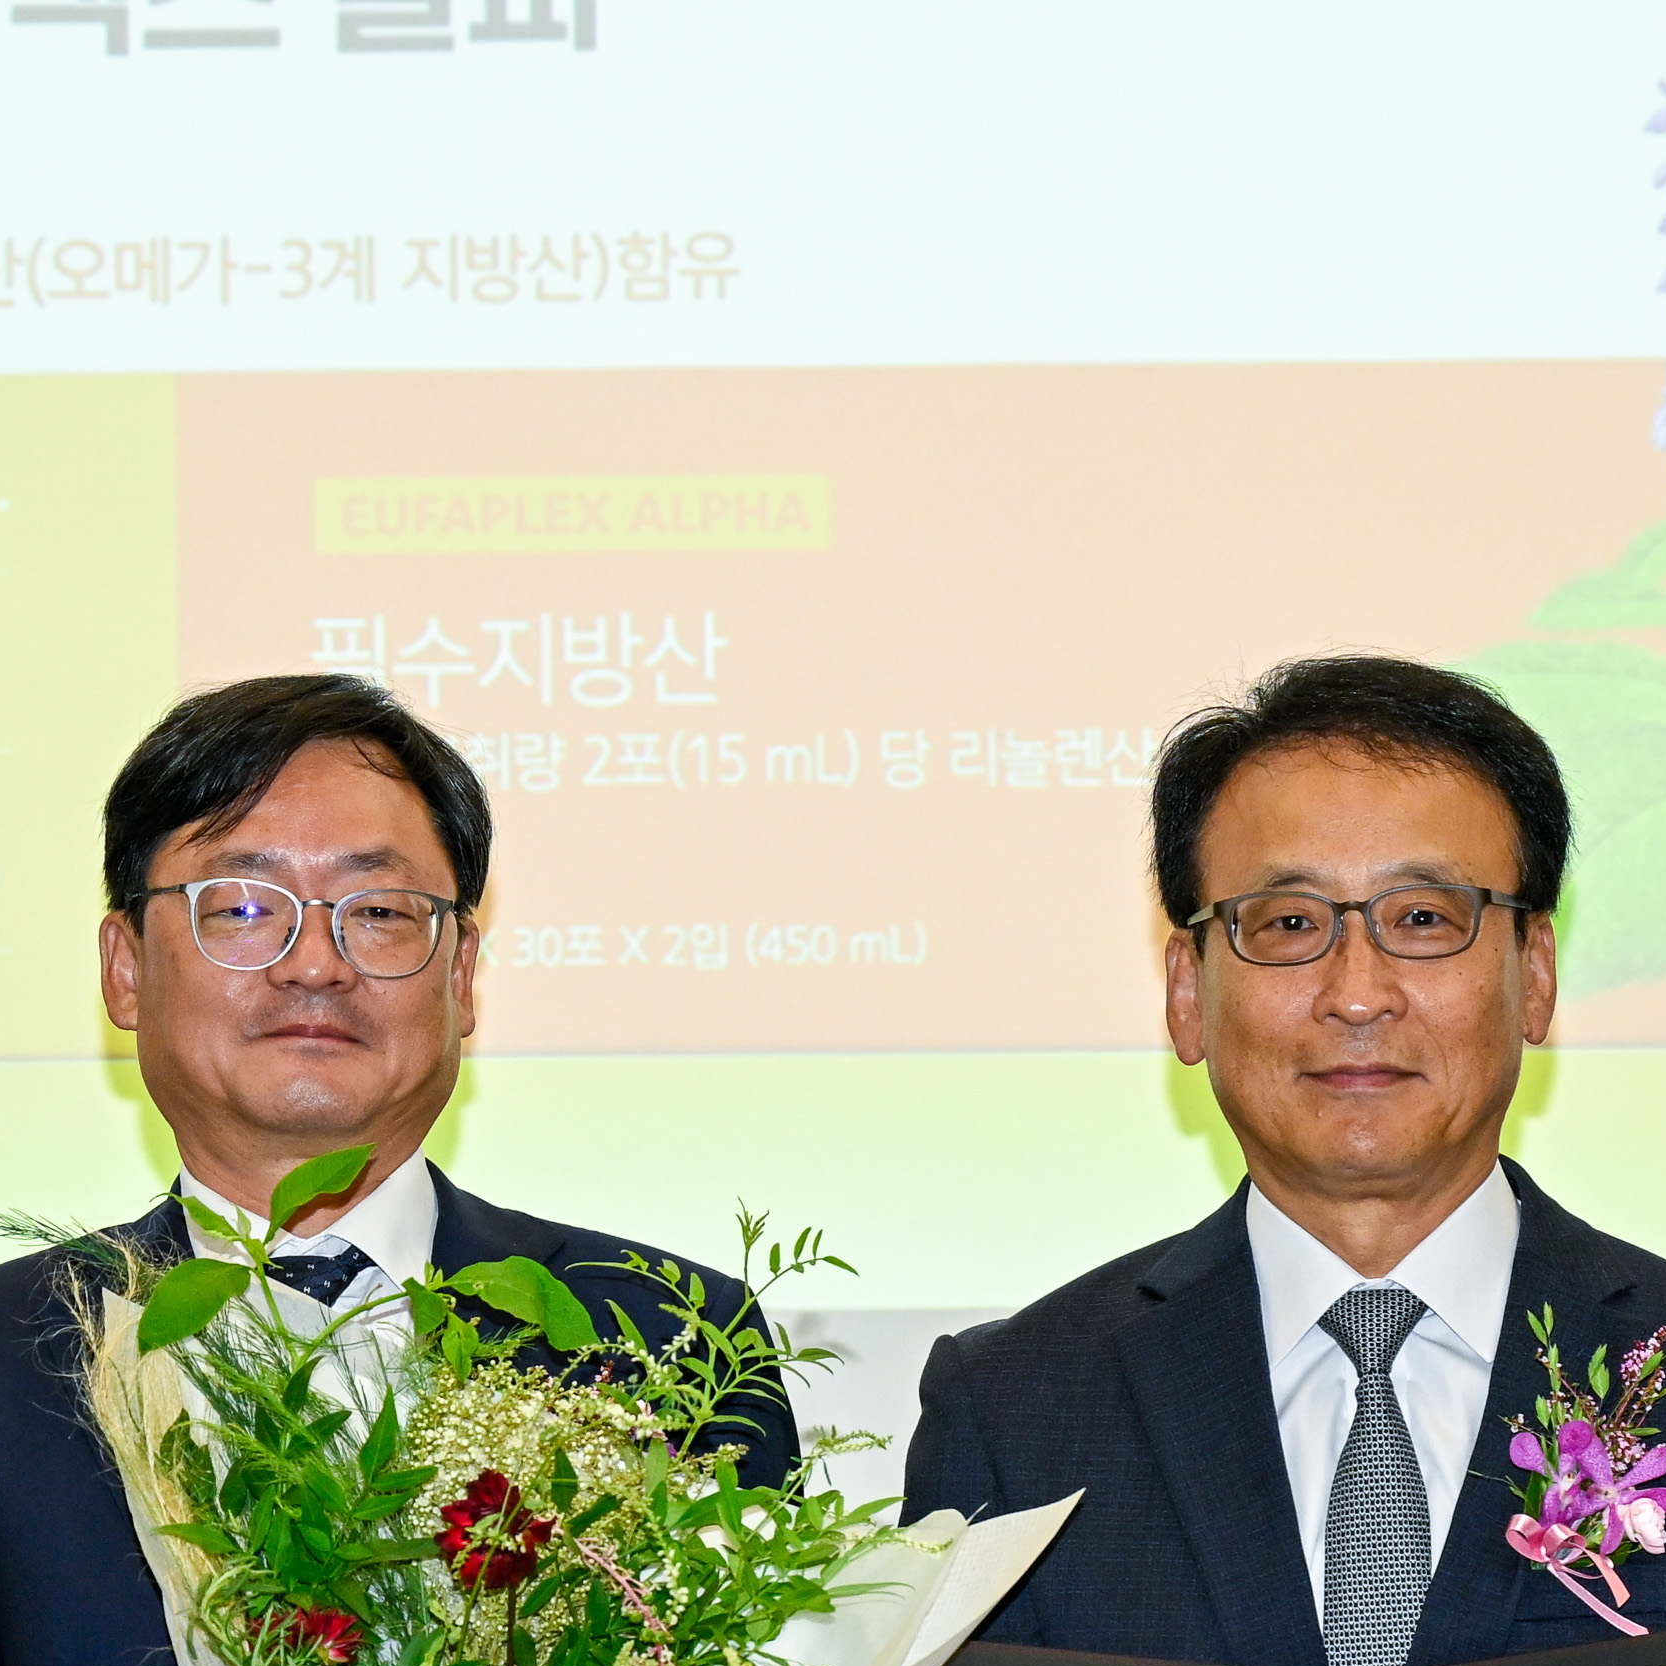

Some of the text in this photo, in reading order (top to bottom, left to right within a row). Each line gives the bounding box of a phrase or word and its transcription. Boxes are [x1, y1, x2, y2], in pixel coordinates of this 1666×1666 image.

[402, 228, 741, 305] 지방산)함유
[342, 490, 812, 538] EUFAPLEX ALPHA
[311, 610, 729, 708] 필수지방산
[446, 726, 1157, 793] 취량 2포(15 mL) 당 리놀렌산
[512, 925, 606, 968] 30포
[618, 926, 650, 964] X
[662, 922, 729, 970] 2입
[745, 921, 839, 968] (450
[850, 921, 928, 967] mL)
